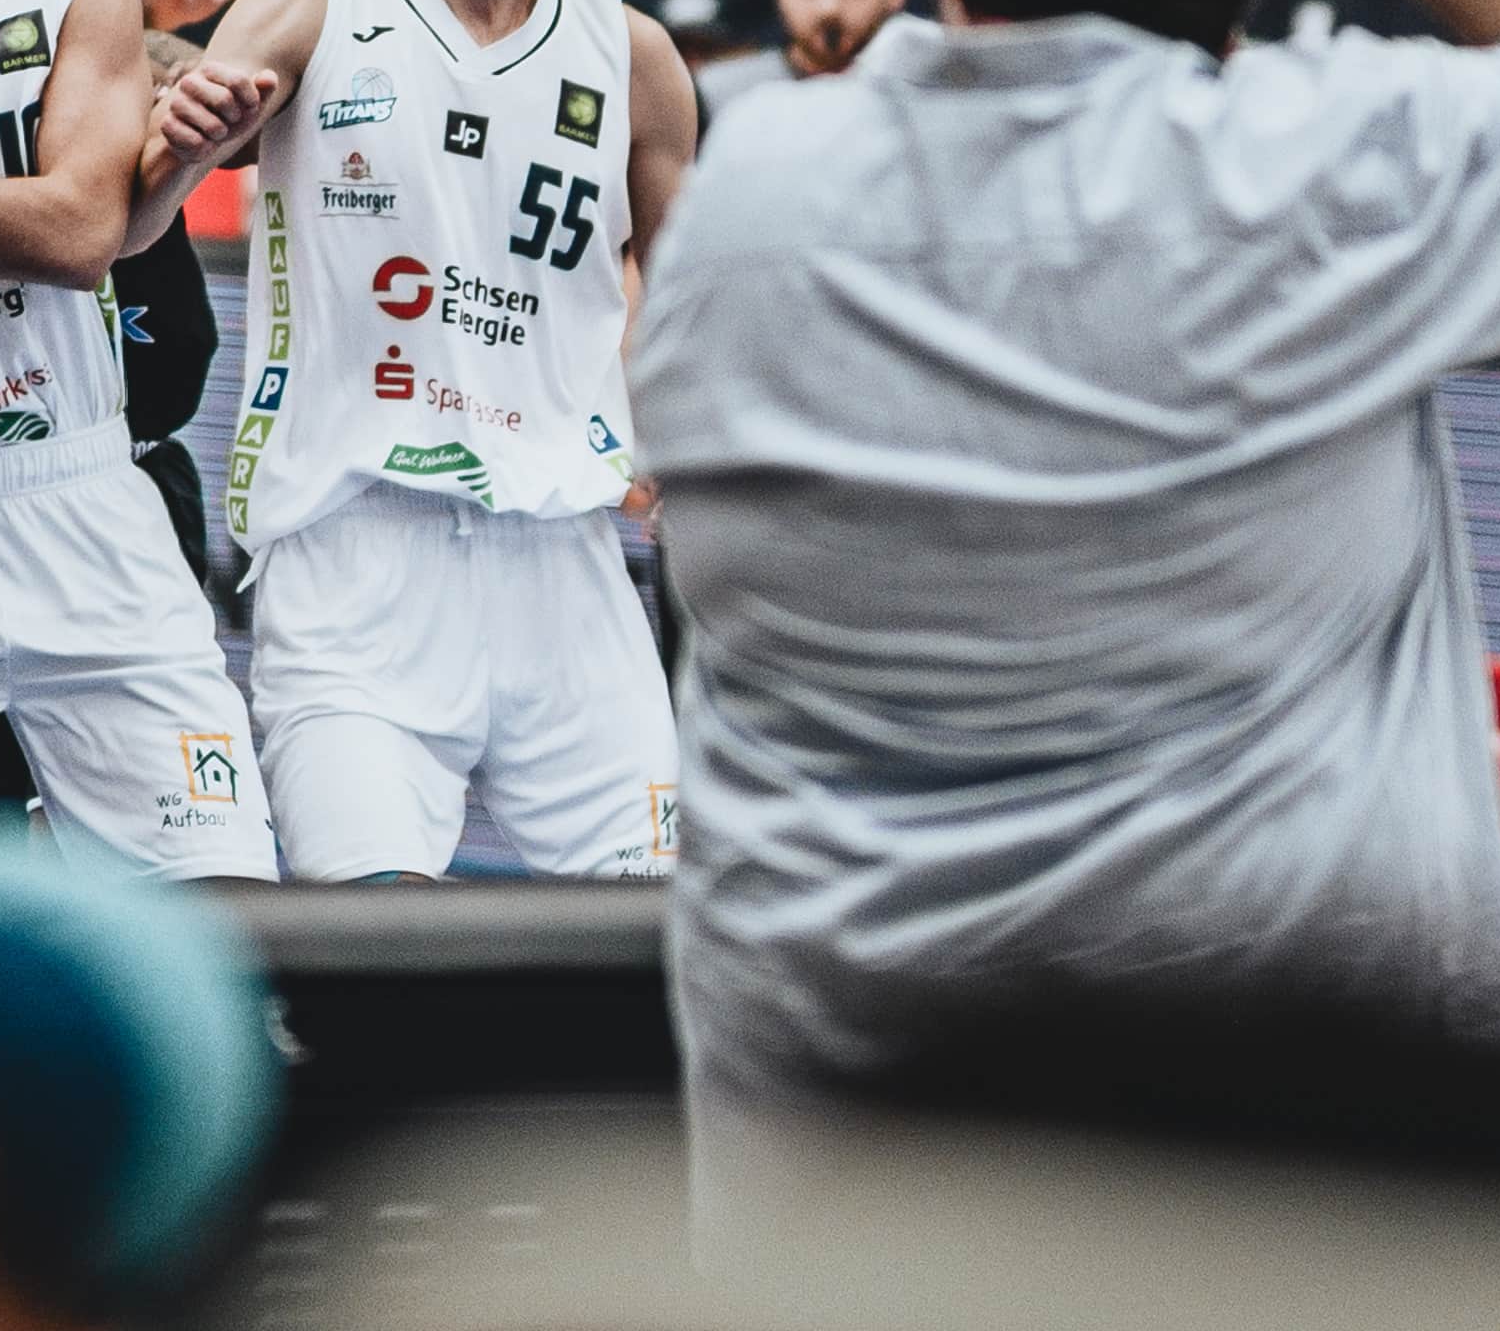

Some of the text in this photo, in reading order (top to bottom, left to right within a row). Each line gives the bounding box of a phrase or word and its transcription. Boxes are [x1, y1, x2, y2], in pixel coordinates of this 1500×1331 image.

[2, 53, 48, 70] BARMER
[320, 96, 397, 131] TITANS
[321, 187, 396, 215] Freiberger
[509, 162, 600, 272] 55
[156, 791, 183, 808] WG
[161, 809, 227, 829] Aufbau
[616, 846, 644, 861] WG
